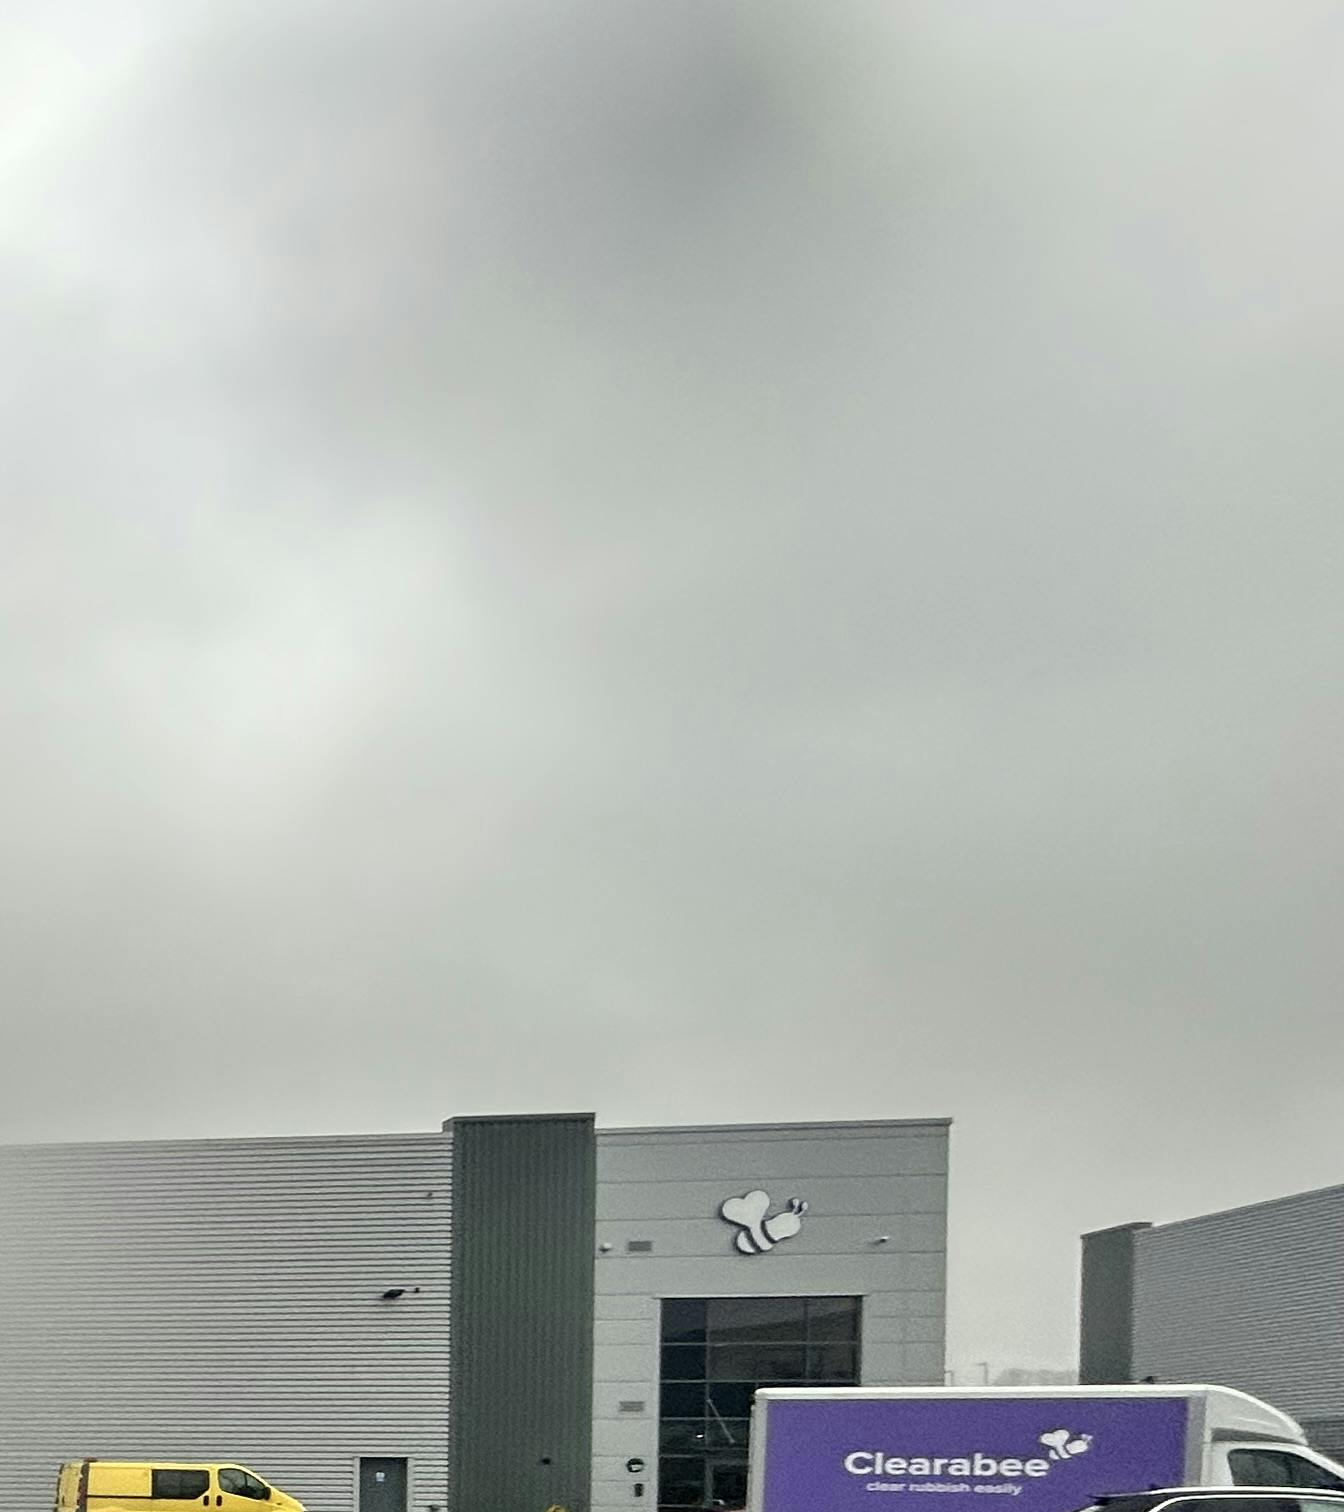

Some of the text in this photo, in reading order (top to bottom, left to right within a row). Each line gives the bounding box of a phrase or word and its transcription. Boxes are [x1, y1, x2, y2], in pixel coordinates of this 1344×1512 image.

[843, 1451, 1050, 1477] Clearabee
[866, 1481, 1023, 1496] clear rubbish easily
